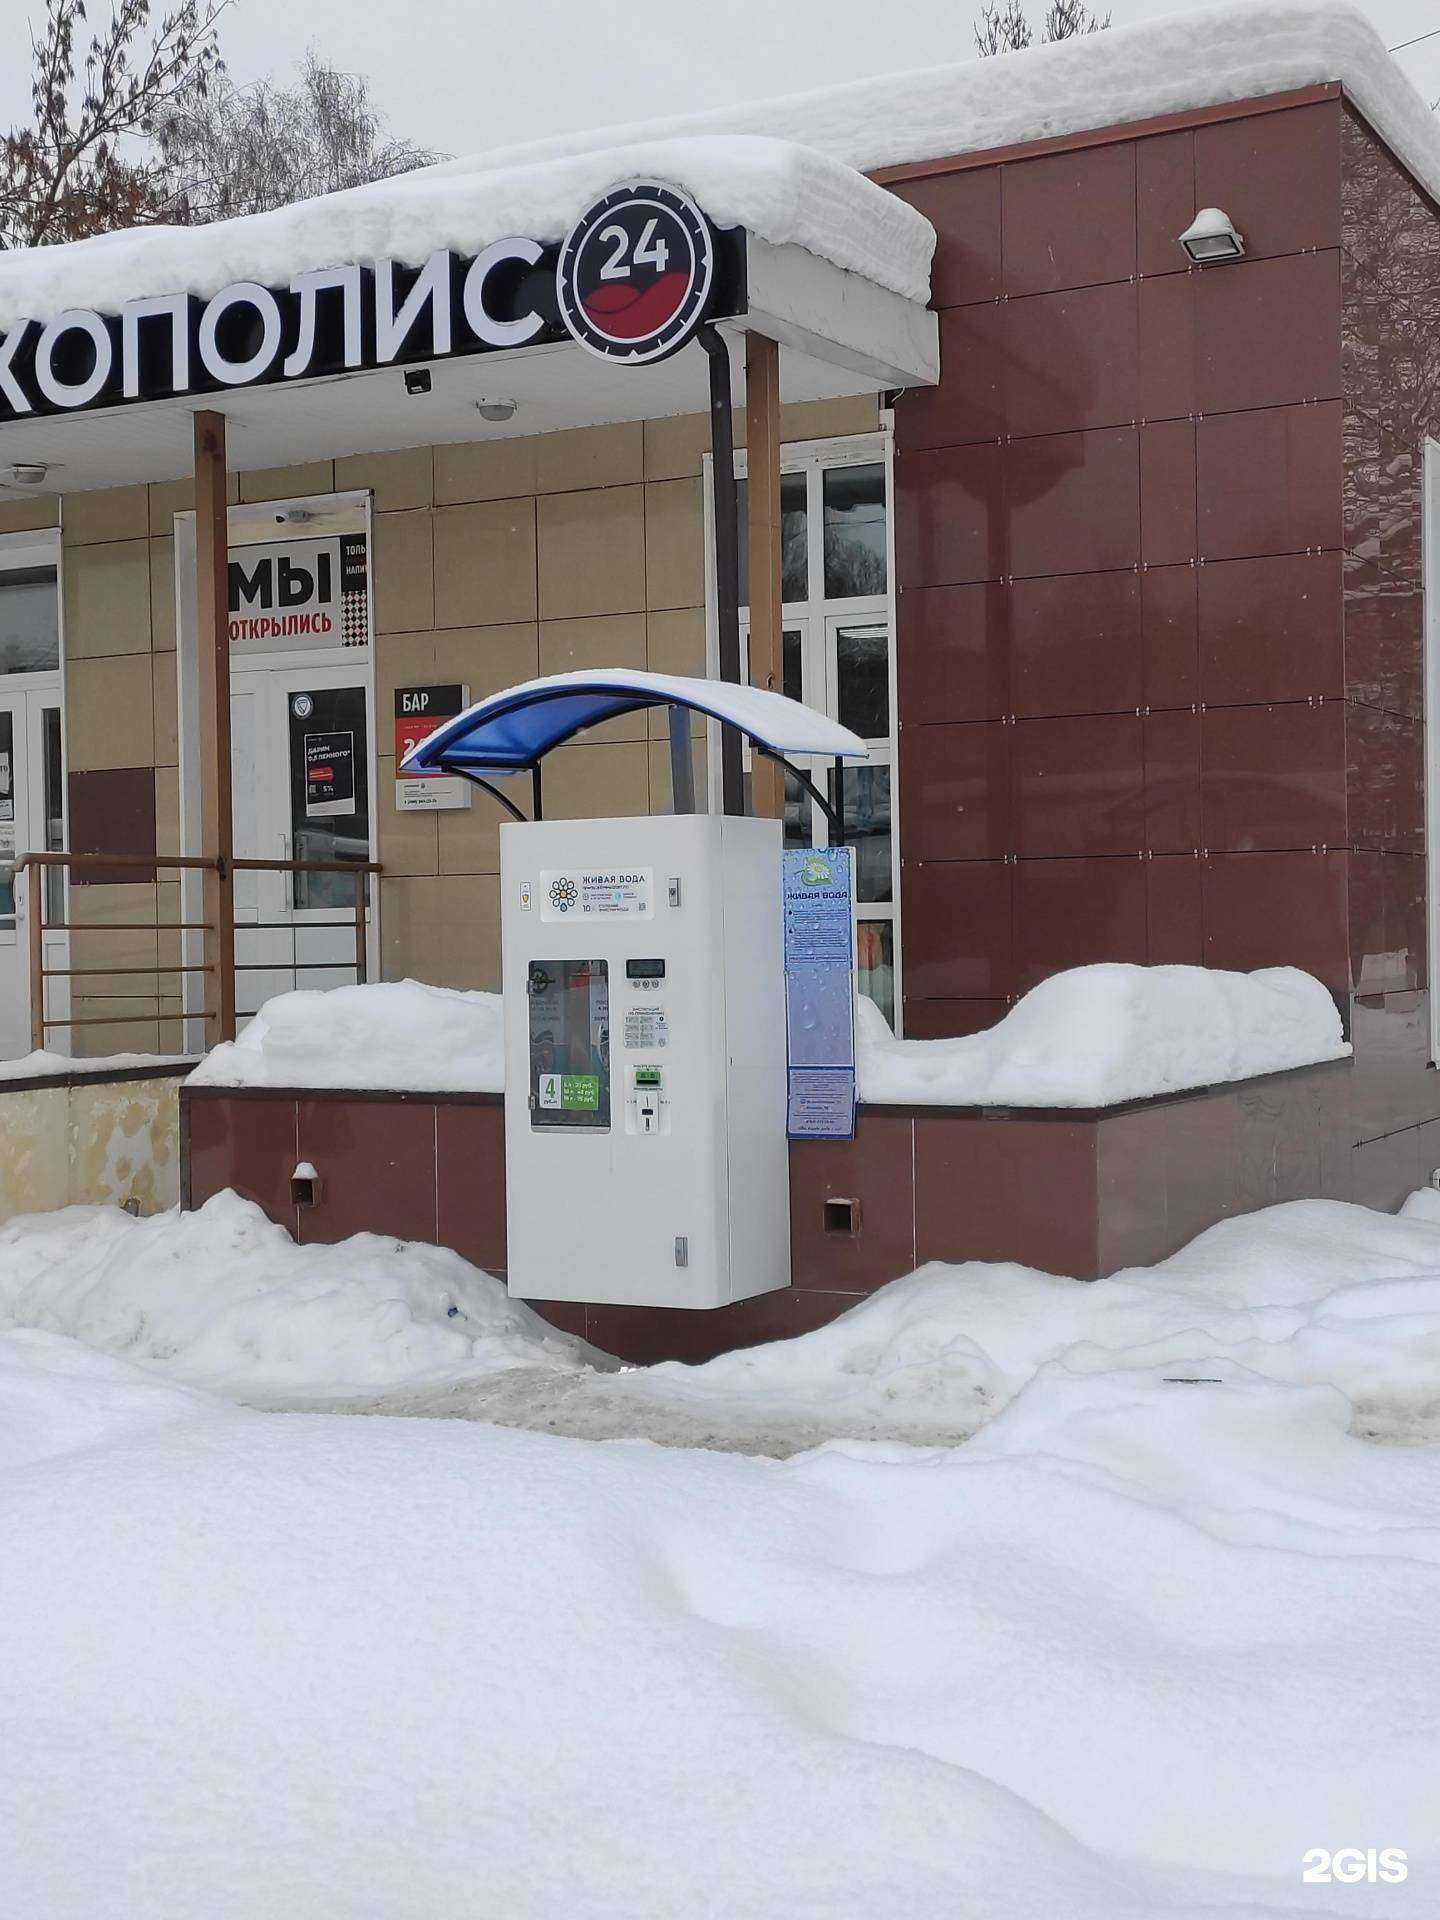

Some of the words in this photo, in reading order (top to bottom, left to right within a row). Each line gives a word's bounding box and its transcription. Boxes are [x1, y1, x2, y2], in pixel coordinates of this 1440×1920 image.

[598, 217, 669, 281] 24
[345, 565, 368, 575] НАПИ
[228, 553, 332, 612] МЫ
[228, 612, 332, 641] ОТКРЫЛИСЬ
[402, 693, 429, 712] БАР
[582, 875, 616, 884] ЖИВАЯ
[619, 874, 645, 883] ВОДА
[787, 892, 820, 900] ЖИВАЯ
[822, 891, 848, 899] ВОДА
[582, 904, 591, 912] 10
[545, 1078, 556, 1099] 4
